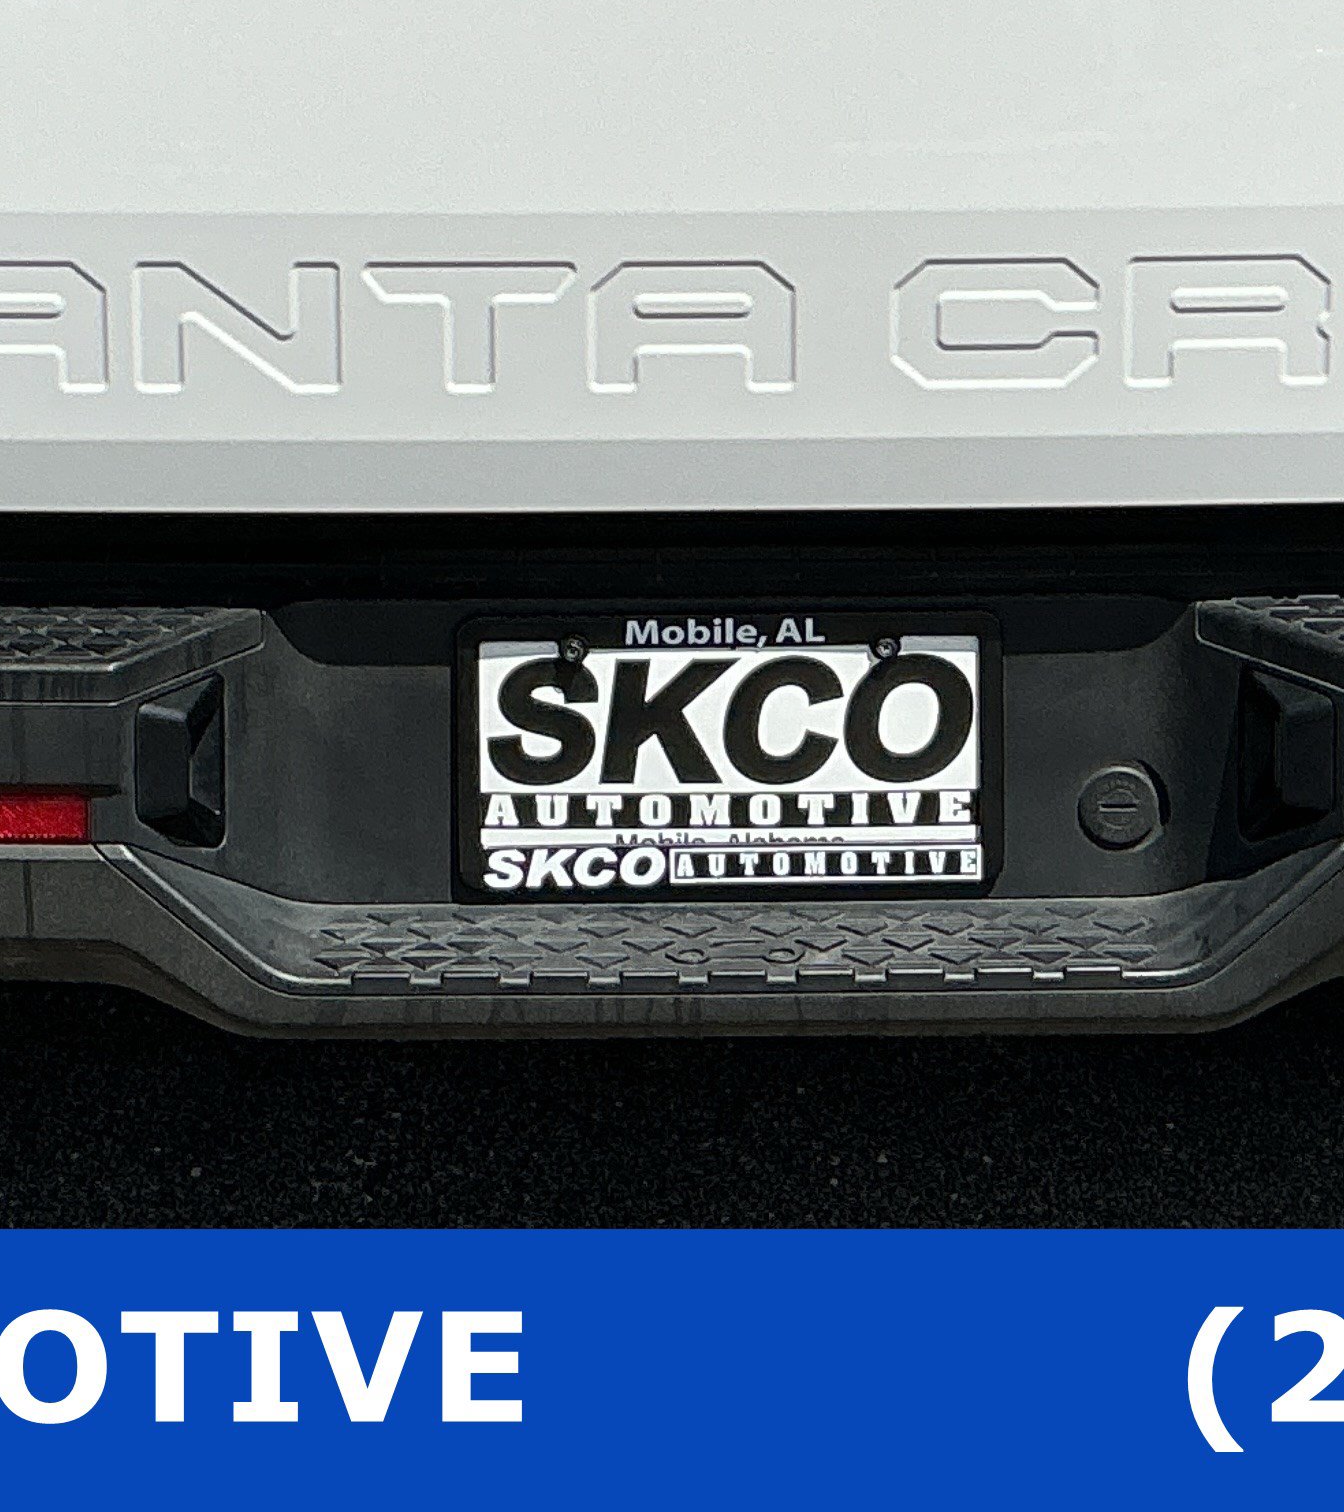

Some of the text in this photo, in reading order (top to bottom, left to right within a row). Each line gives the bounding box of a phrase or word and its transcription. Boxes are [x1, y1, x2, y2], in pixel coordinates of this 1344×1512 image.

[625, 617, 826, 648] Mobile, AL
[486, 654, 974, 785] SKCO
[484, 790, 972, 827] AUTOMOTIVE
[483, 846, 978, 889] SKCO AUTOMOTIVE
